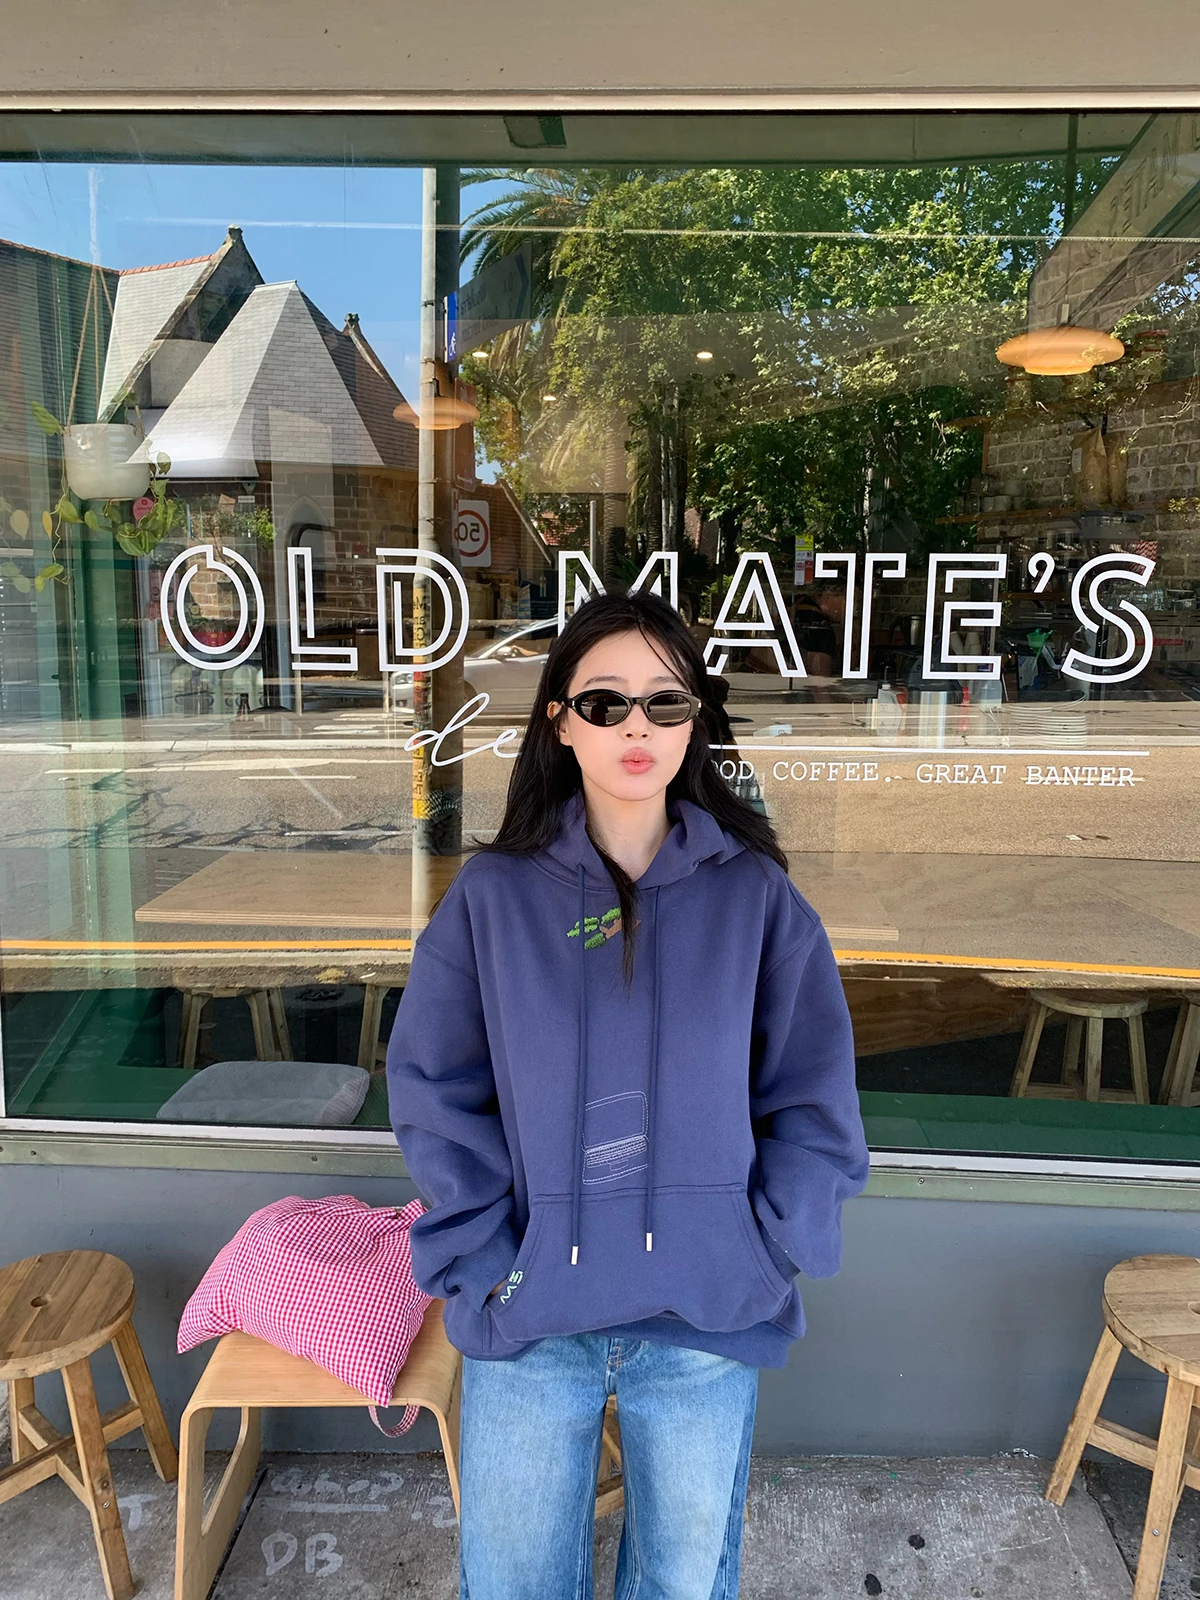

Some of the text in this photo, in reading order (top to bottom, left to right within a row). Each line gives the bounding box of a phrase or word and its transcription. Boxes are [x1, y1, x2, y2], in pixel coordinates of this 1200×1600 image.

[160, 545, 470, 672] OLD
[404, 692, 520, 767] de
[711, 760, 1135, 787] OD COFFEE. GREAT BANTER
